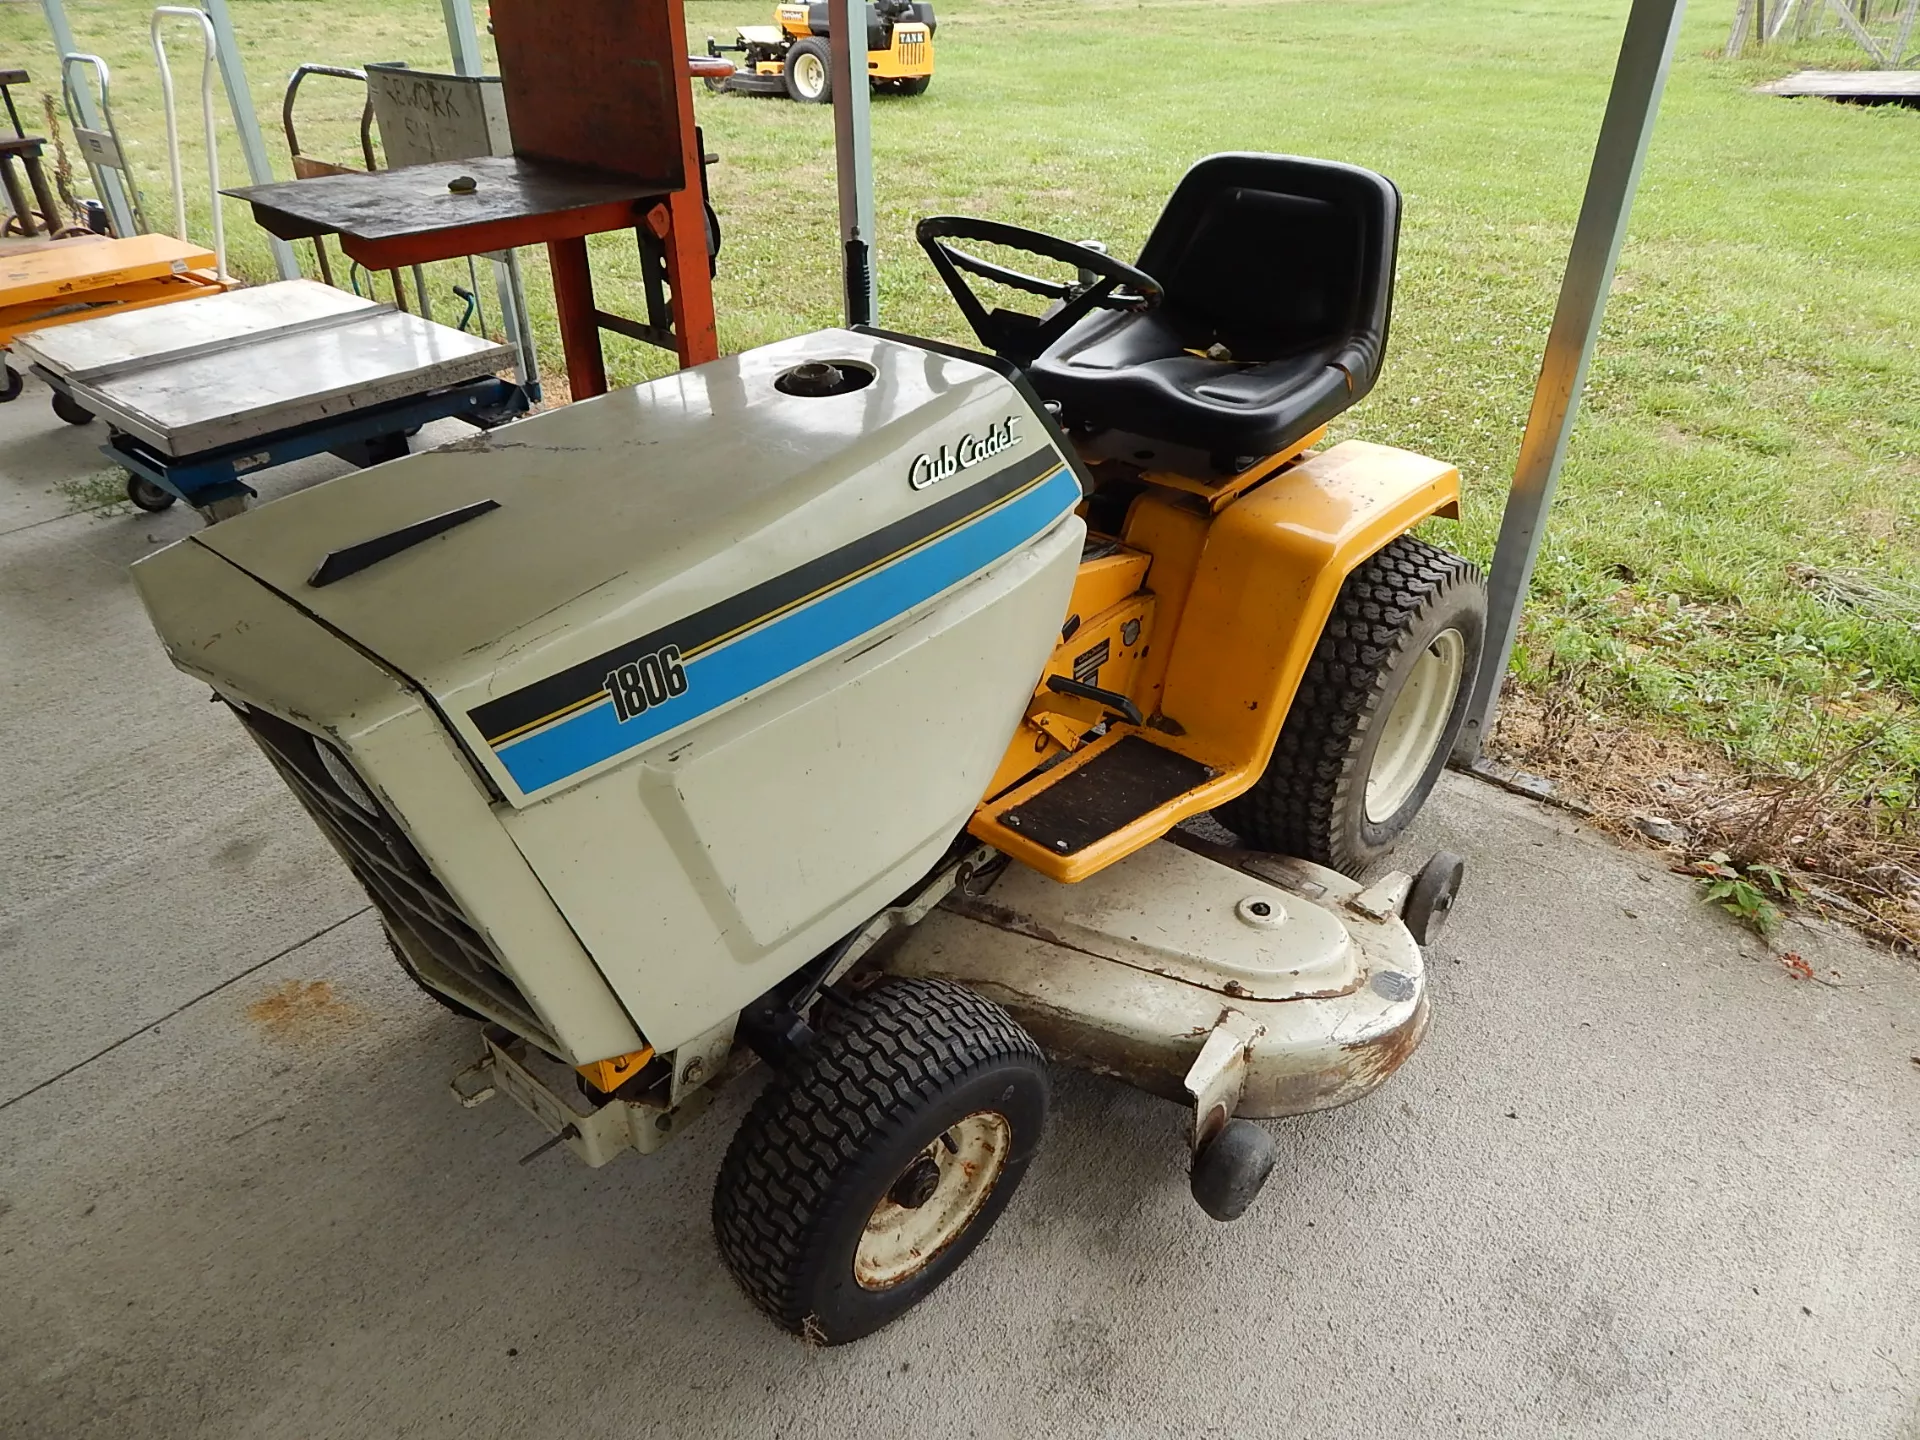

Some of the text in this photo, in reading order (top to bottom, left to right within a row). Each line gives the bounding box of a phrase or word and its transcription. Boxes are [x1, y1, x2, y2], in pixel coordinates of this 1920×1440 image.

[899, 32, 924, 43] TANK
[908, 416, 1024, 491] Cub Cadet
[602, 643, 689, 725] 1806
